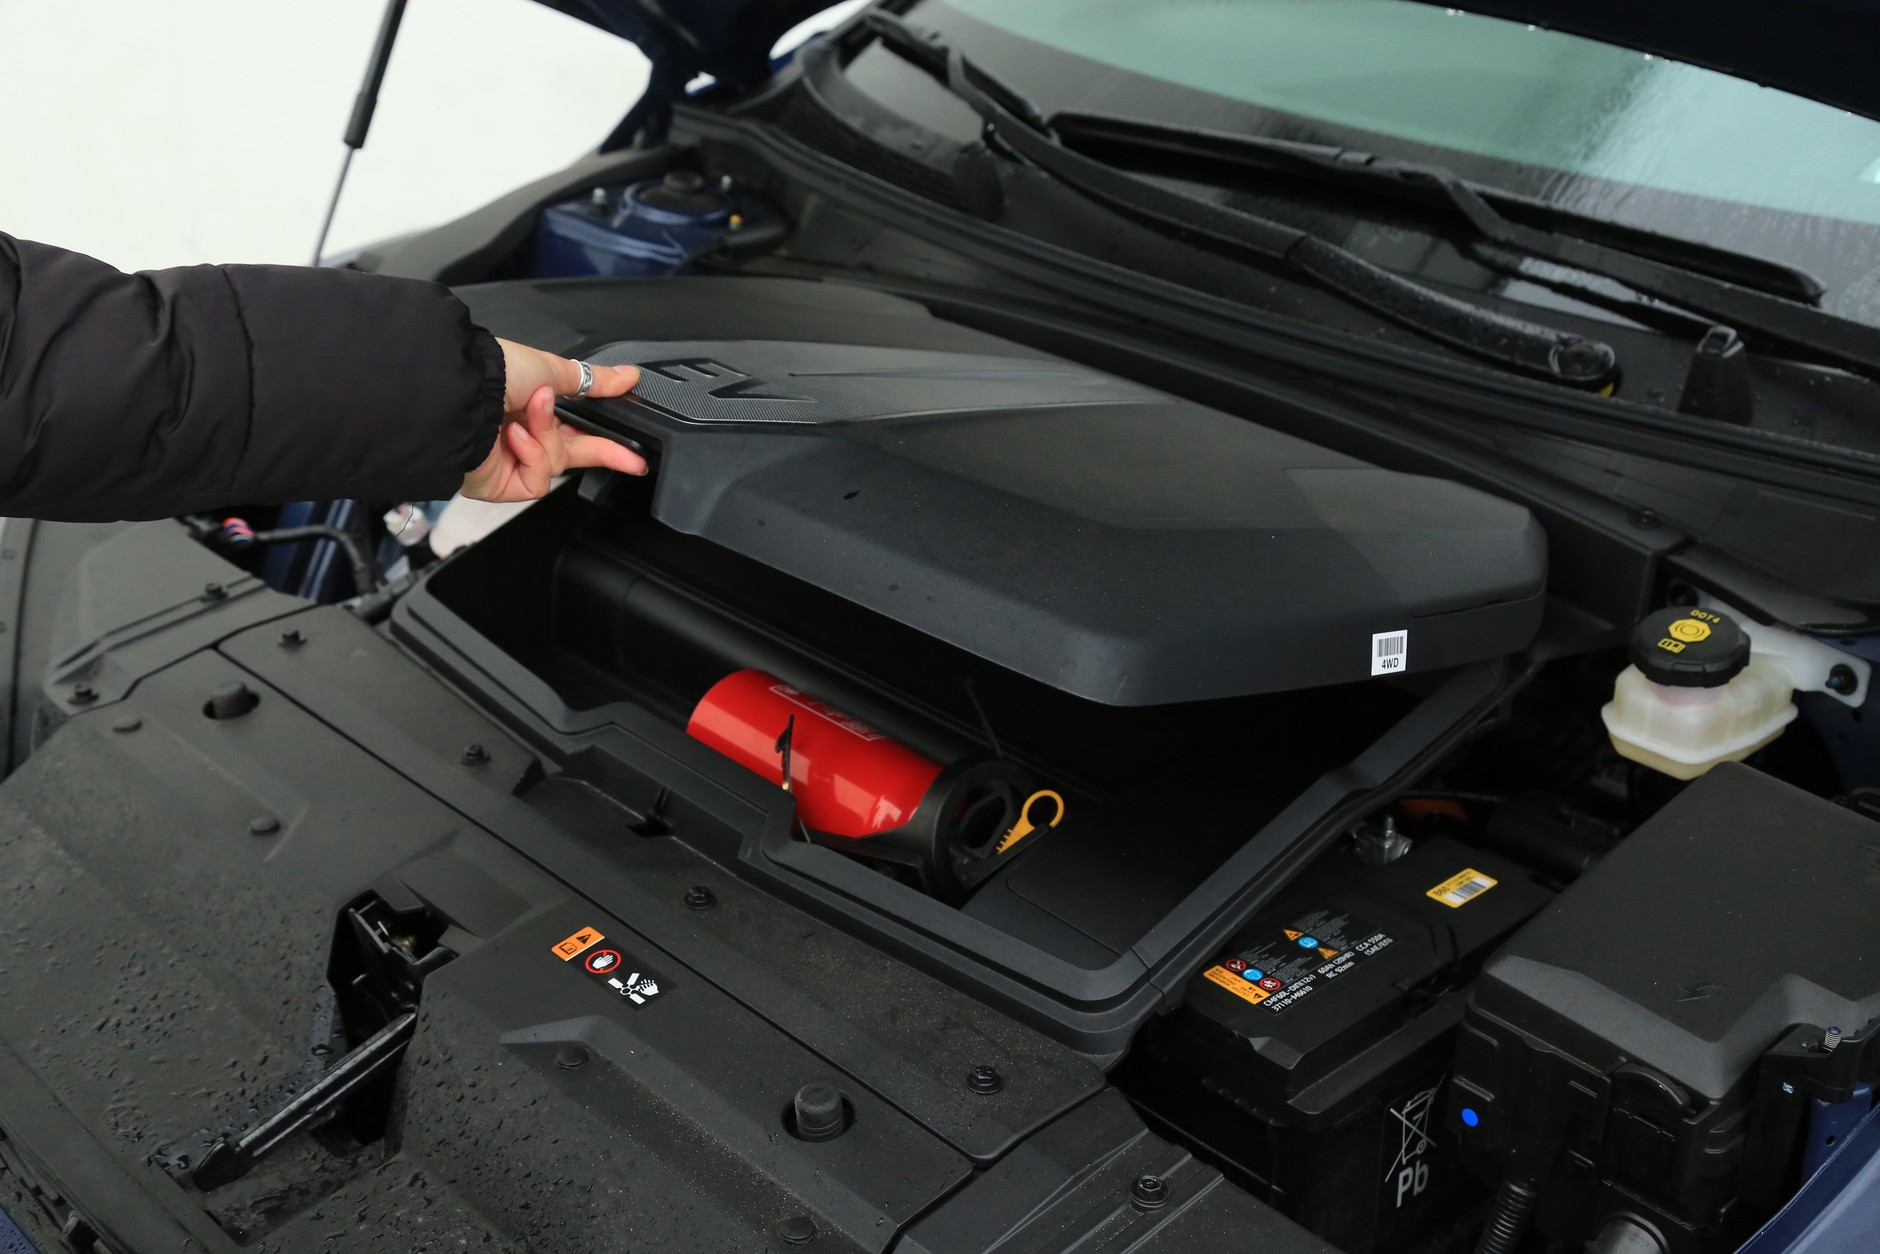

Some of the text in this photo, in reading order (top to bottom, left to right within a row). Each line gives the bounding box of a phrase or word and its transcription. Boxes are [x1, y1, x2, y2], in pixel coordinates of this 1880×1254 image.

[636, 357, 817, 402] EV
[1381, 657, 1399, 669] 4WD
[1317, 963, 1336, 975] 60Ah
[1333, 951, 1355, 965] (20HR)
[1355, 942, 1371, 952] CCA
[1367, 933, 1387, 945] 550A
[1325, 971, 1338, 979] RC
[1334, 961, 1355, 974] 92min
[1396, 1160, 1429, 1208] Pb
